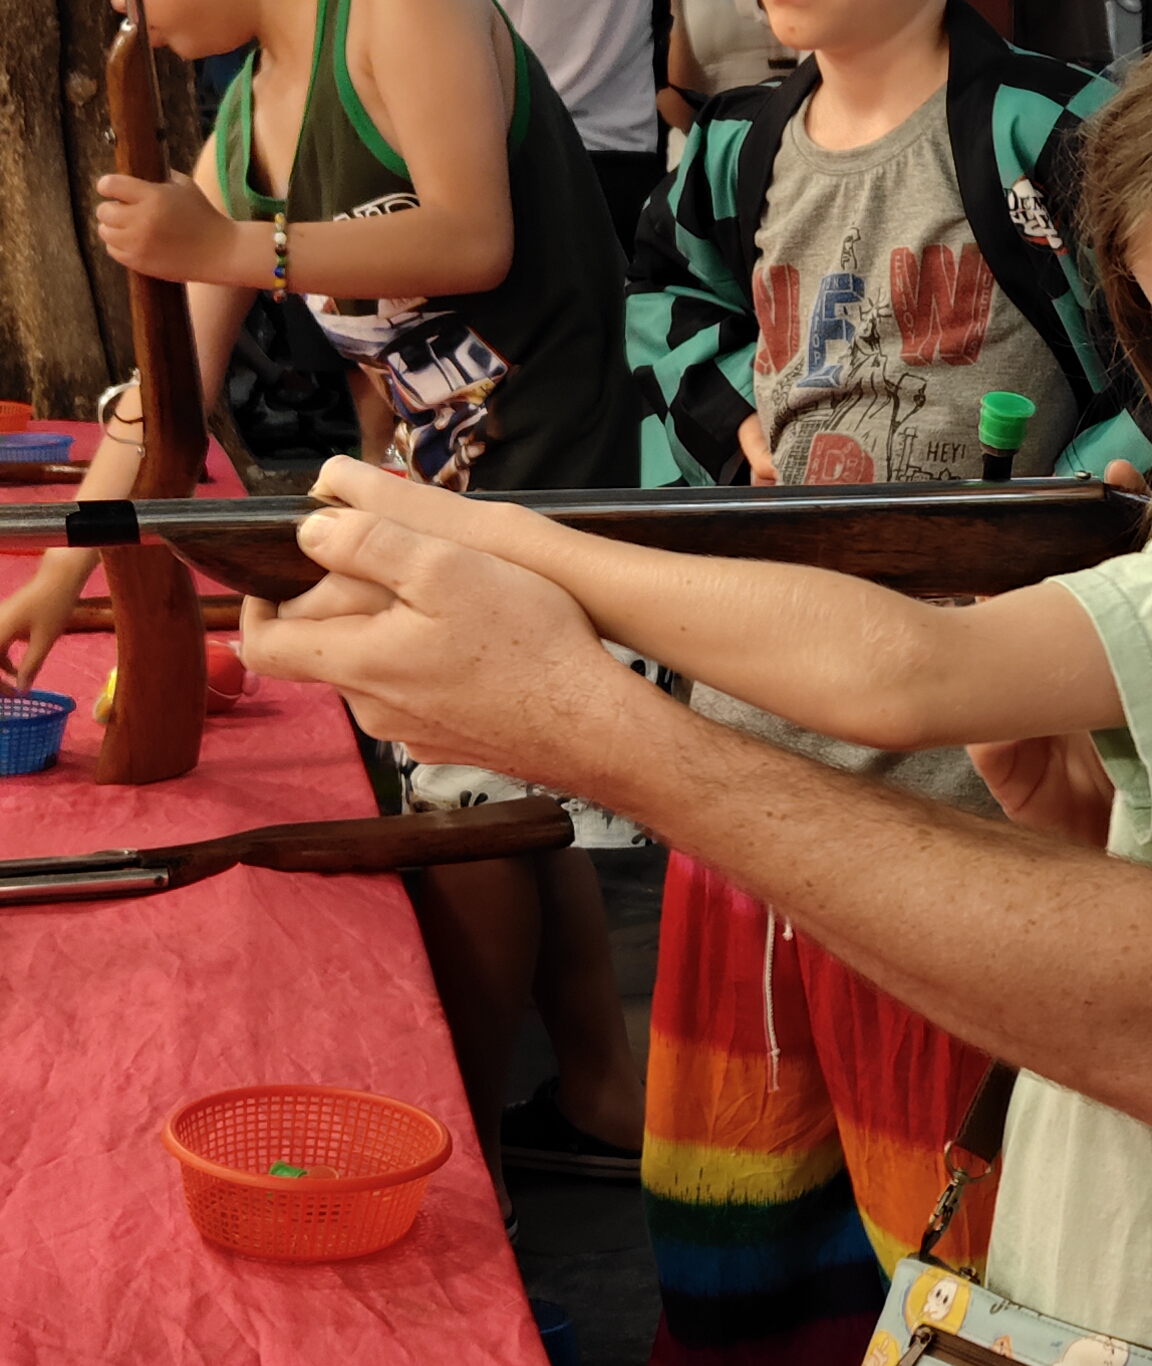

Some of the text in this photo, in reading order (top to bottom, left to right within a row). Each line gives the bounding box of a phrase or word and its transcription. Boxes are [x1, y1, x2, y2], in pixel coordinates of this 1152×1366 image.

[753, 243, 995, 388] NEW
[894, 254, 917, 345] ENJOY
[968, 264, 994, 354] UEENS
